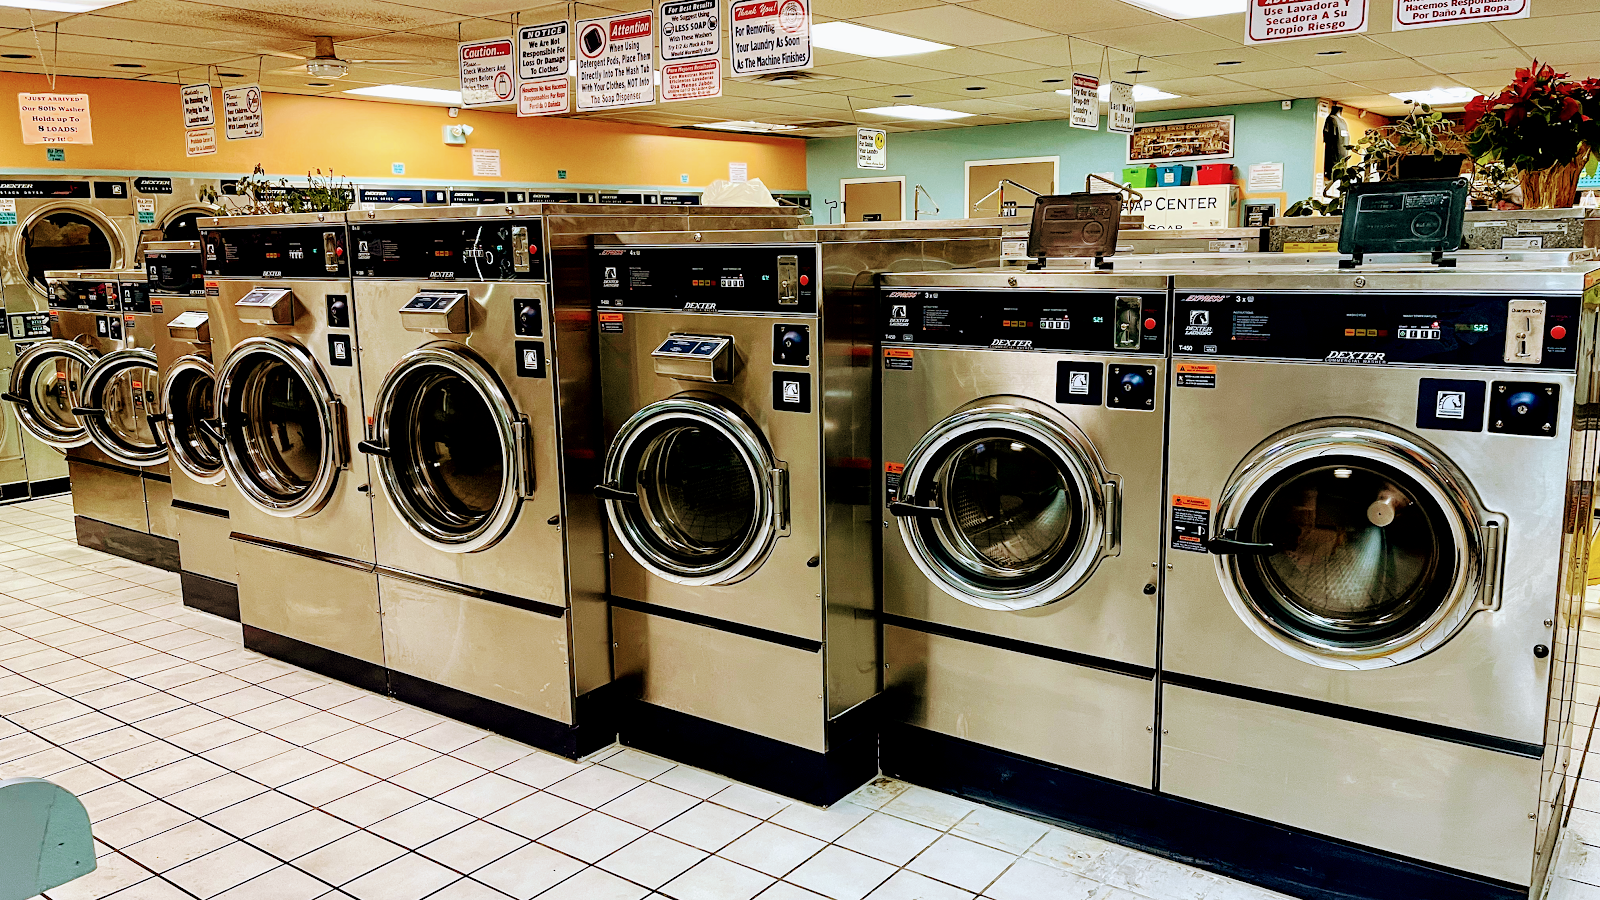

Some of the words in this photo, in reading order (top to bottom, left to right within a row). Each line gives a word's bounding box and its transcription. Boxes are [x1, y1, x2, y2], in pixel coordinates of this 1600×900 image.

[693, 2, 713, 10] Results
[736, 6, 757, 17] Thank
[759, 2, 777, 16] You!
[1264, 7, 1284, 16] Use
[1287, 1, 1339, 13] Lavadora
[1406, 1, 1448, 12] Hacemos
[1266, 13, 1318, 26] Secadora
[1321, 11, 1330, 19] A
[1334, 9, 1348, 18] Su
[1412, 12, 1430, 20] Por
[1432, 9, 1457, 18] Daño
[1469, 6, 1481, 14] La
[1484, 5, 1509, 13] Ropa
[612, 21, 650, 37] Attention
[675, 24, 689, 32] LESS
[690, 21, 707, 30] SOAP
[735, 27, 745, 37] For
[746, 21, 776, 36] Removing
[1266, 25, 1304, 36] Propio
[1308, 21, 1346, 31] Riesgo
[527, 27, 562, 39] NOTICE
[528, 41, 539, 49] We
[550, 37, 560, 45] Not
[609, 43, 624, 53] When
[624, 41, 640, 51] Using
[736, 42, 750, 53] Your
[750, 39, 775, 51] Laundry
[776, 37, 783, 48] As
[784, 36, 800, 46] Soon
[464, 46, 505, 59] Caution...
[522, 47, 556, 58] Responsible
[544, 56, 566, 64] Damage
[580, 58, 606, 70] Detergent
[606, 56, 621, 66] Pods,
[622, 54, 636, 64] Place
[637, 52, 651, 62] Them
[737, 59, 744, 69] As
[744, 58, 756, 68] The
[757, 55, 781, 67] Machine
[782, 52, 806, 64] Finishes
[477, 65, 496, 73] Washers
[530, 67, 537, 75] To
[538, 65, 559, 73] Clothes
[581, 70, 601, 81] Directly
[603, 69, 614, 78] Into
[614, 67, 625, 77] The
[626, 65, 640, 75] Wash
[640, 64, 650, 73] Tub
[464, 76, 479, 84] Dryers
[581, 83, 593, 92] With
[593, 82, 605, 92] Your
[627, 78, 638, 88] NOT
[639, 77, 650, 86] Into
[591, 95, 600, 104] The
[601, 94, 615, 104] Soap
[616, 92, 641, 102] Dispenser
[1156, 197, 1217, 211] CENTER
[991, 339, 1033, 347] DEXTER
[1326, 350, 1386, 361] DEXTER
